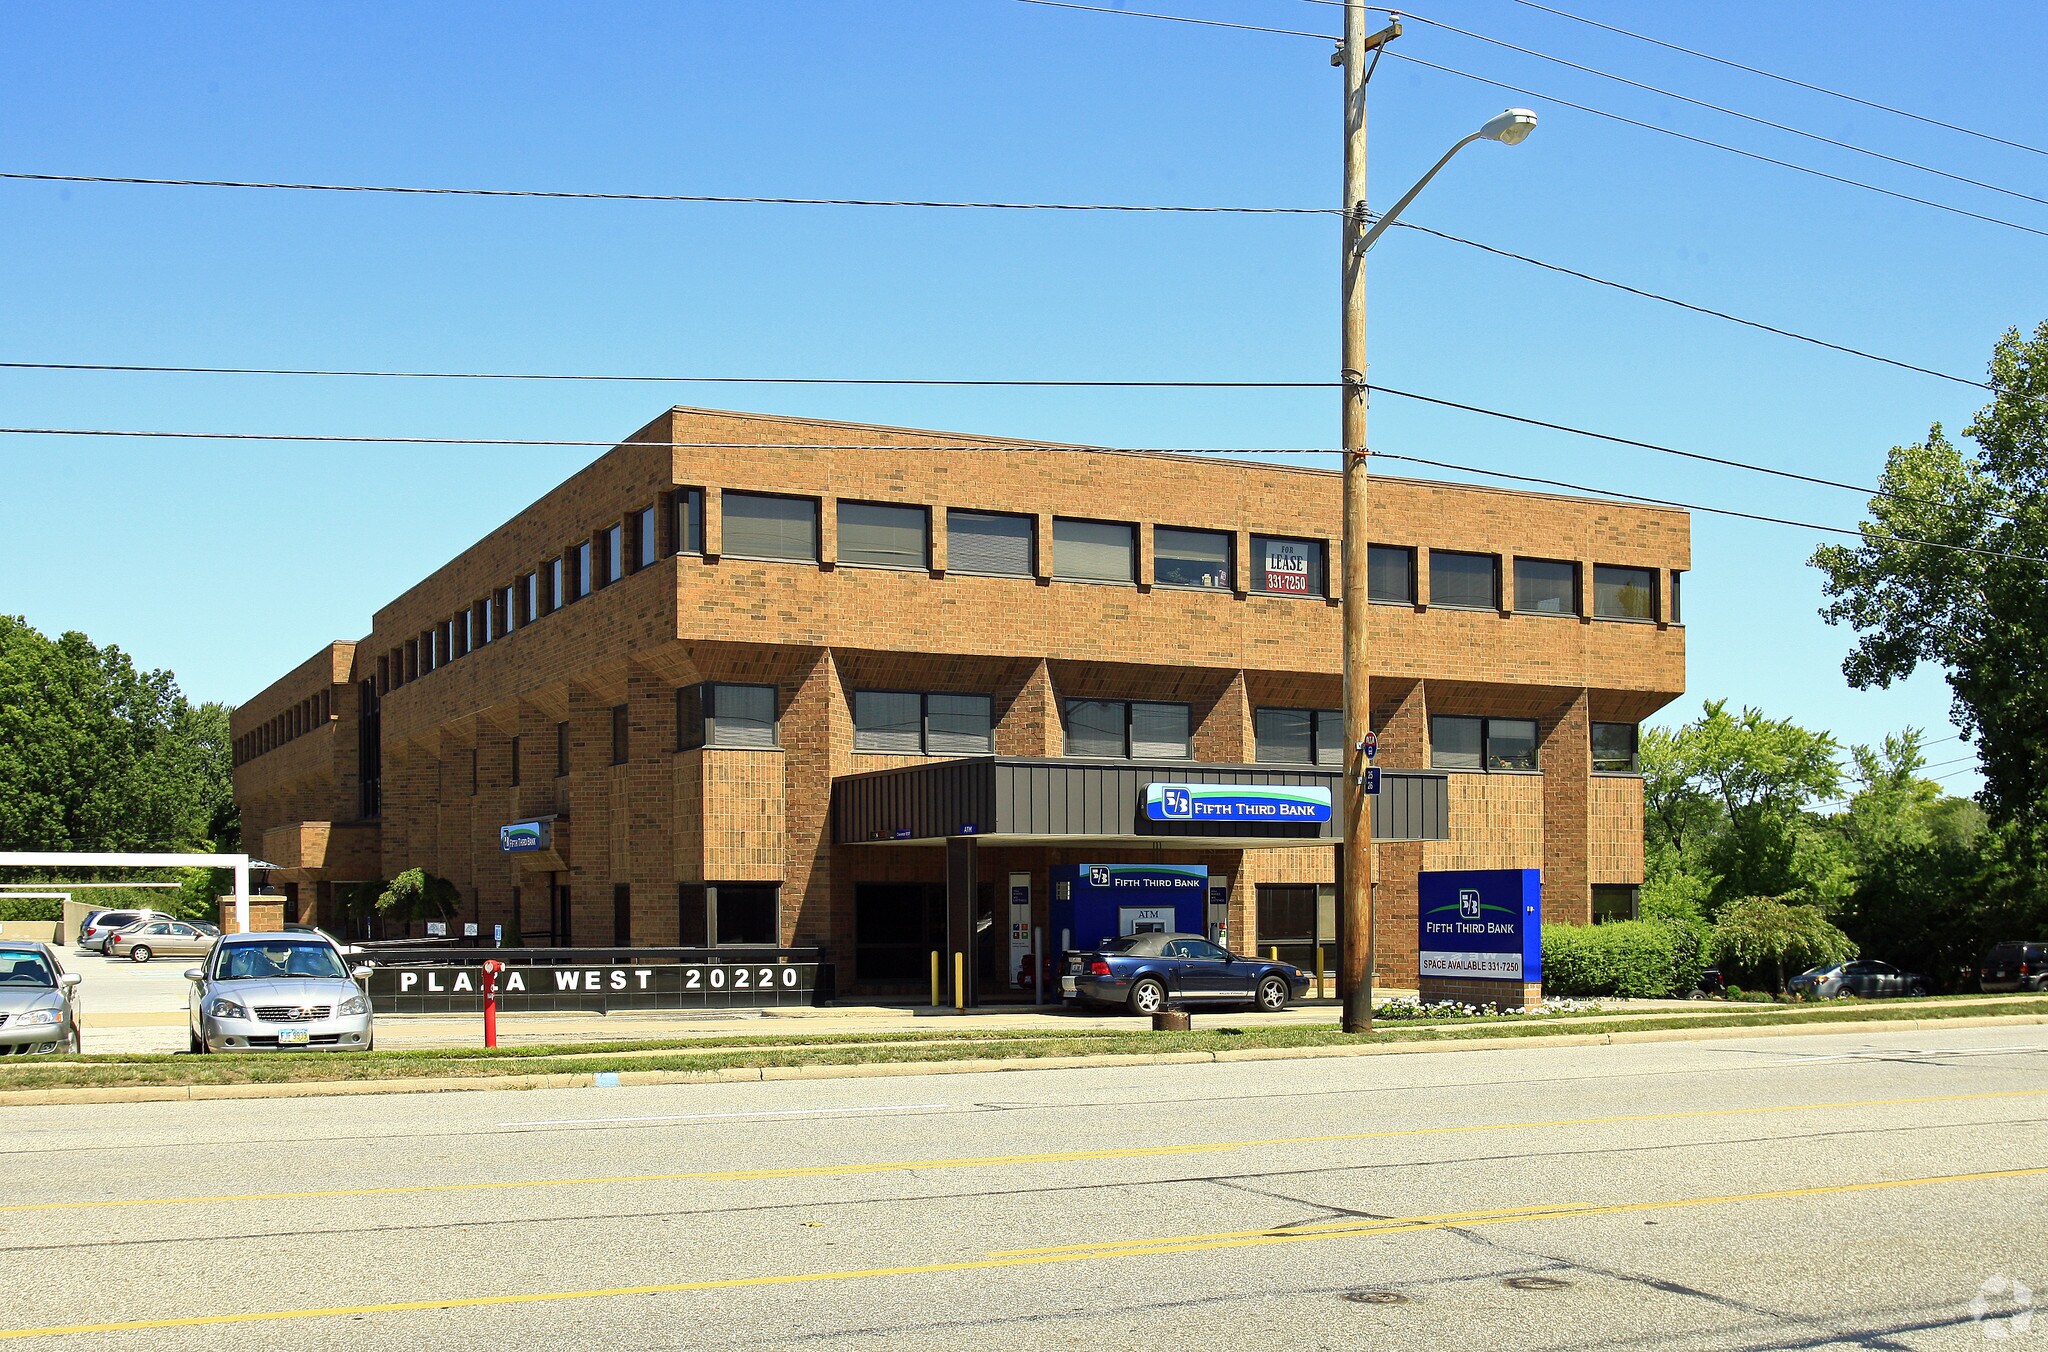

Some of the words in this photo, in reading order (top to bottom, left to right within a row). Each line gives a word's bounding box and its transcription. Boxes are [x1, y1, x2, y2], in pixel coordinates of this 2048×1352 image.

[1271, 554, 1303, 570] LEASE
[1268, 574, 1306, 590] 331-7250
[1194, 802, 1232, 815] FIFTH
[1235, 803, 1276, 815] THIRD
[1279, 803, 1316, 816] BANK
[963, 825, 973, 833] ATM
[1114, 878, 1141, 887] FIFTH
[1143, 878, 1172, 887] THIRD
[1174, 878, 1200, 888] BANK
[1138, 910, 1160, 919] ATM
[1426, 921, 1453, 933] FIFTH
[1456, 922, 1486, 934] THIRD
[1487, 922, 1515, 934] BANK
[1423, 959, 1447, 969] SPACE
[1447, 960, 1487, 971] AVAILABLE
[1488, 961, 1519, 972] 331-7250
[554, 970, 652, 990] WEST
[685, 968, 797, 989] 20220
